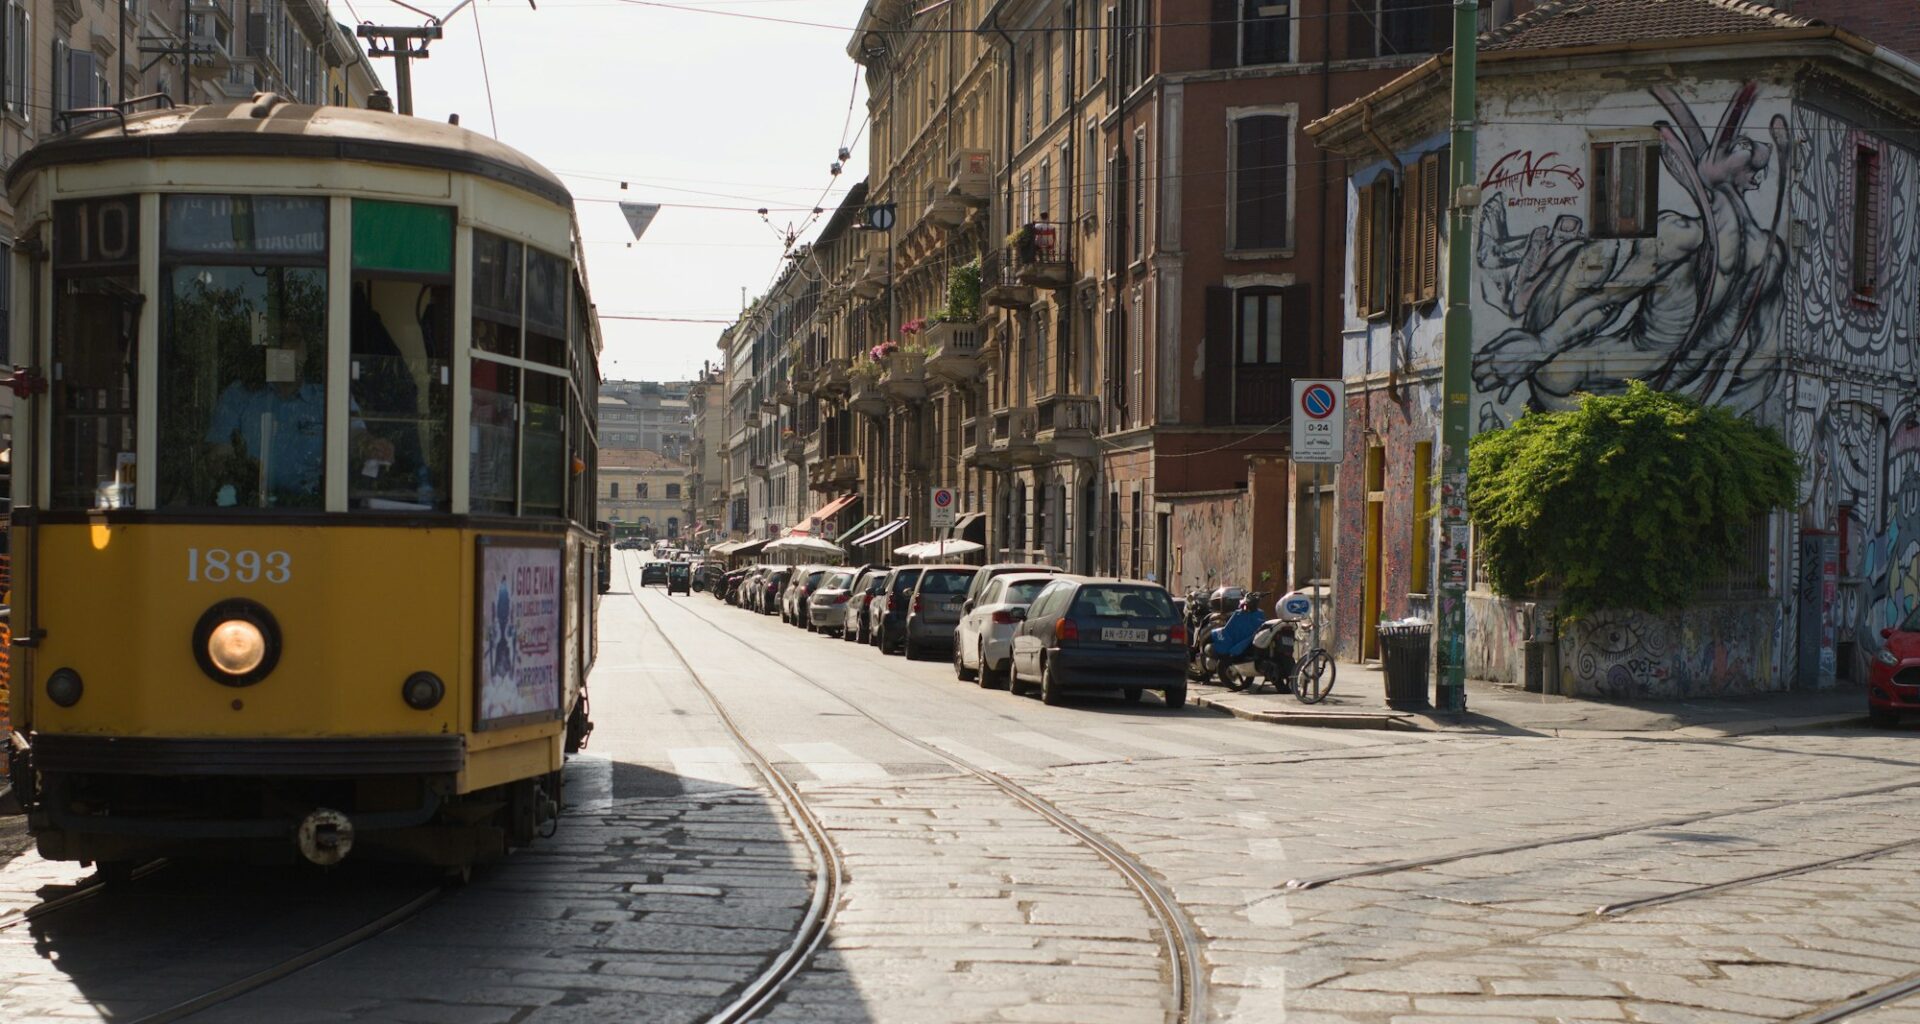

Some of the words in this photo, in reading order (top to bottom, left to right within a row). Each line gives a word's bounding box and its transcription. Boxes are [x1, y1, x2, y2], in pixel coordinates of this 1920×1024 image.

[79, 201, 129, 261] 10
[1308, 424, 1329, 432] 0-24
[187, 548, 291, 583] 1893
[516, 566, 531, 595] GIO
[534, 566, 555, 594] EVAN
[1104, 629, 1114, 638] AN
